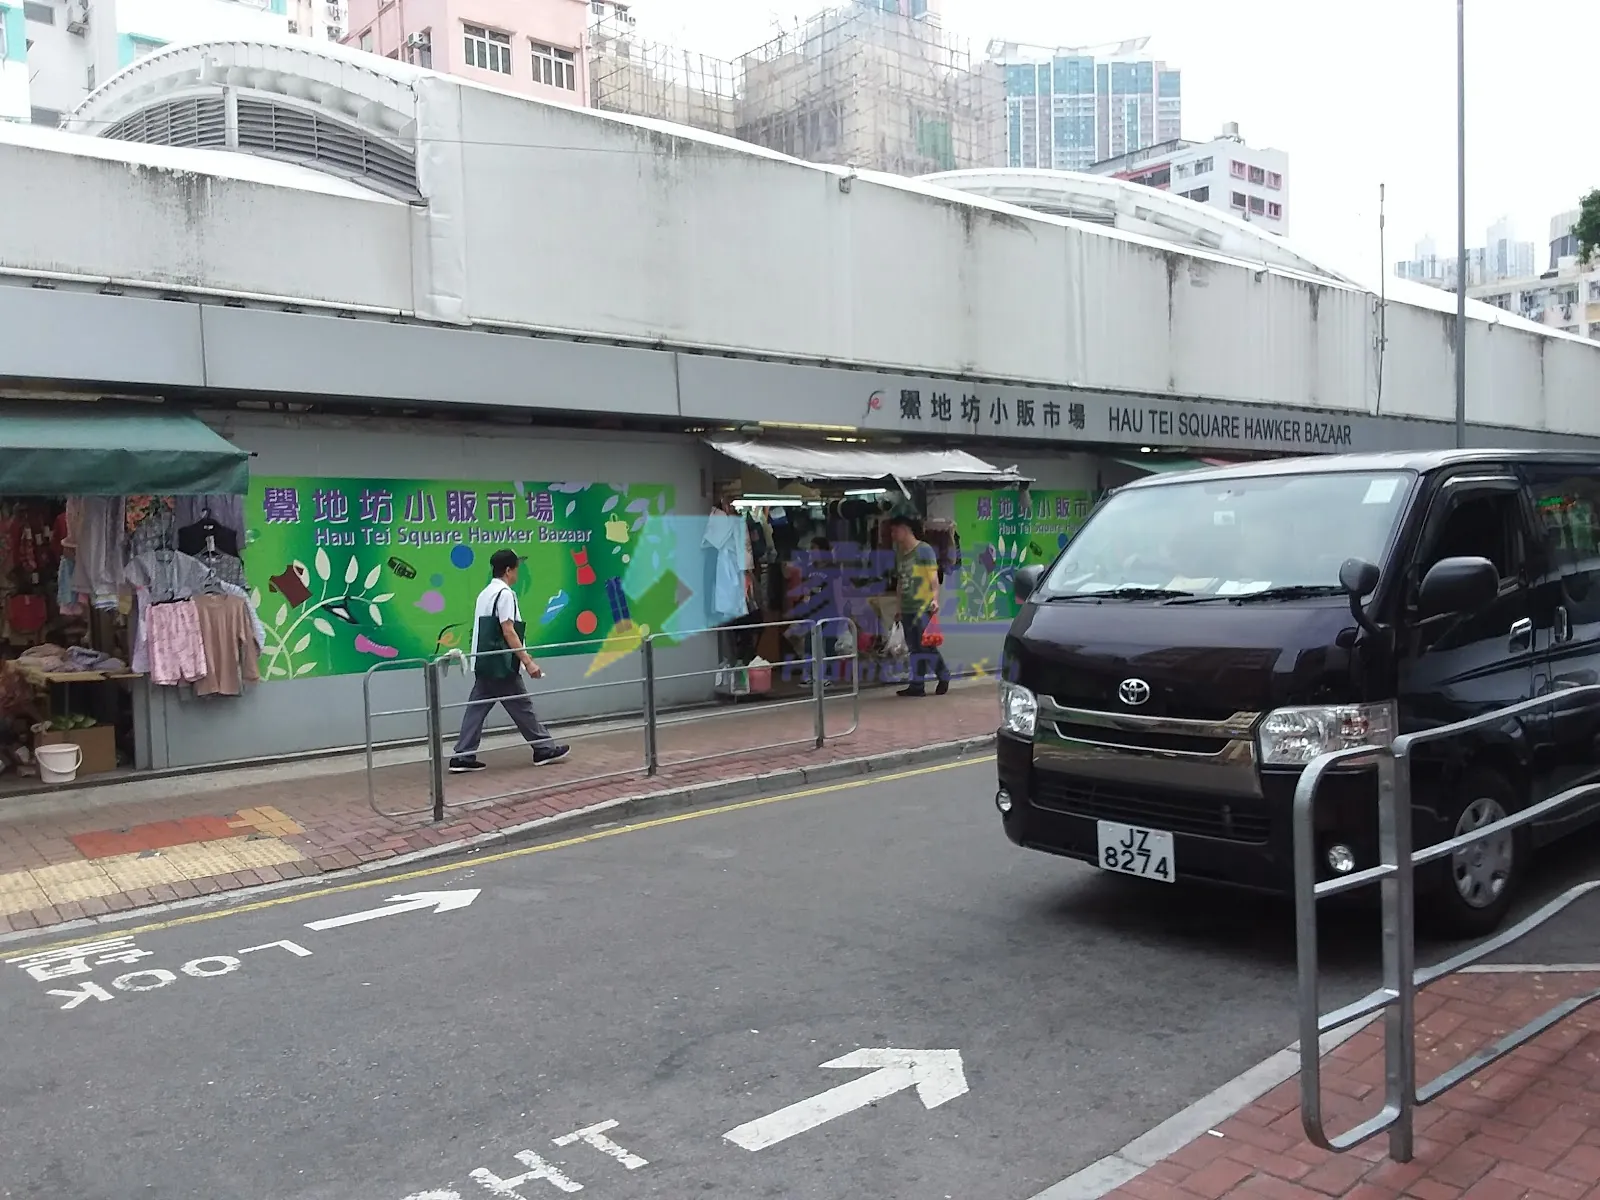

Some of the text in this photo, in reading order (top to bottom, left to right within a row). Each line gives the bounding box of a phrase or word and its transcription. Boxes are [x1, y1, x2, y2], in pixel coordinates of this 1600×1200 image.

[1109, 406, 1352, 446] HAU TEI SQUARE HAWKER BAZAAR
[315, 525, 592, 548] Hau Tei Square Hawker Bazaar
[1120, 828, 1150, 851] JZ
[1104, 846, 1169, 879] 8274
[46, 939, 313, 1009] LOOK
